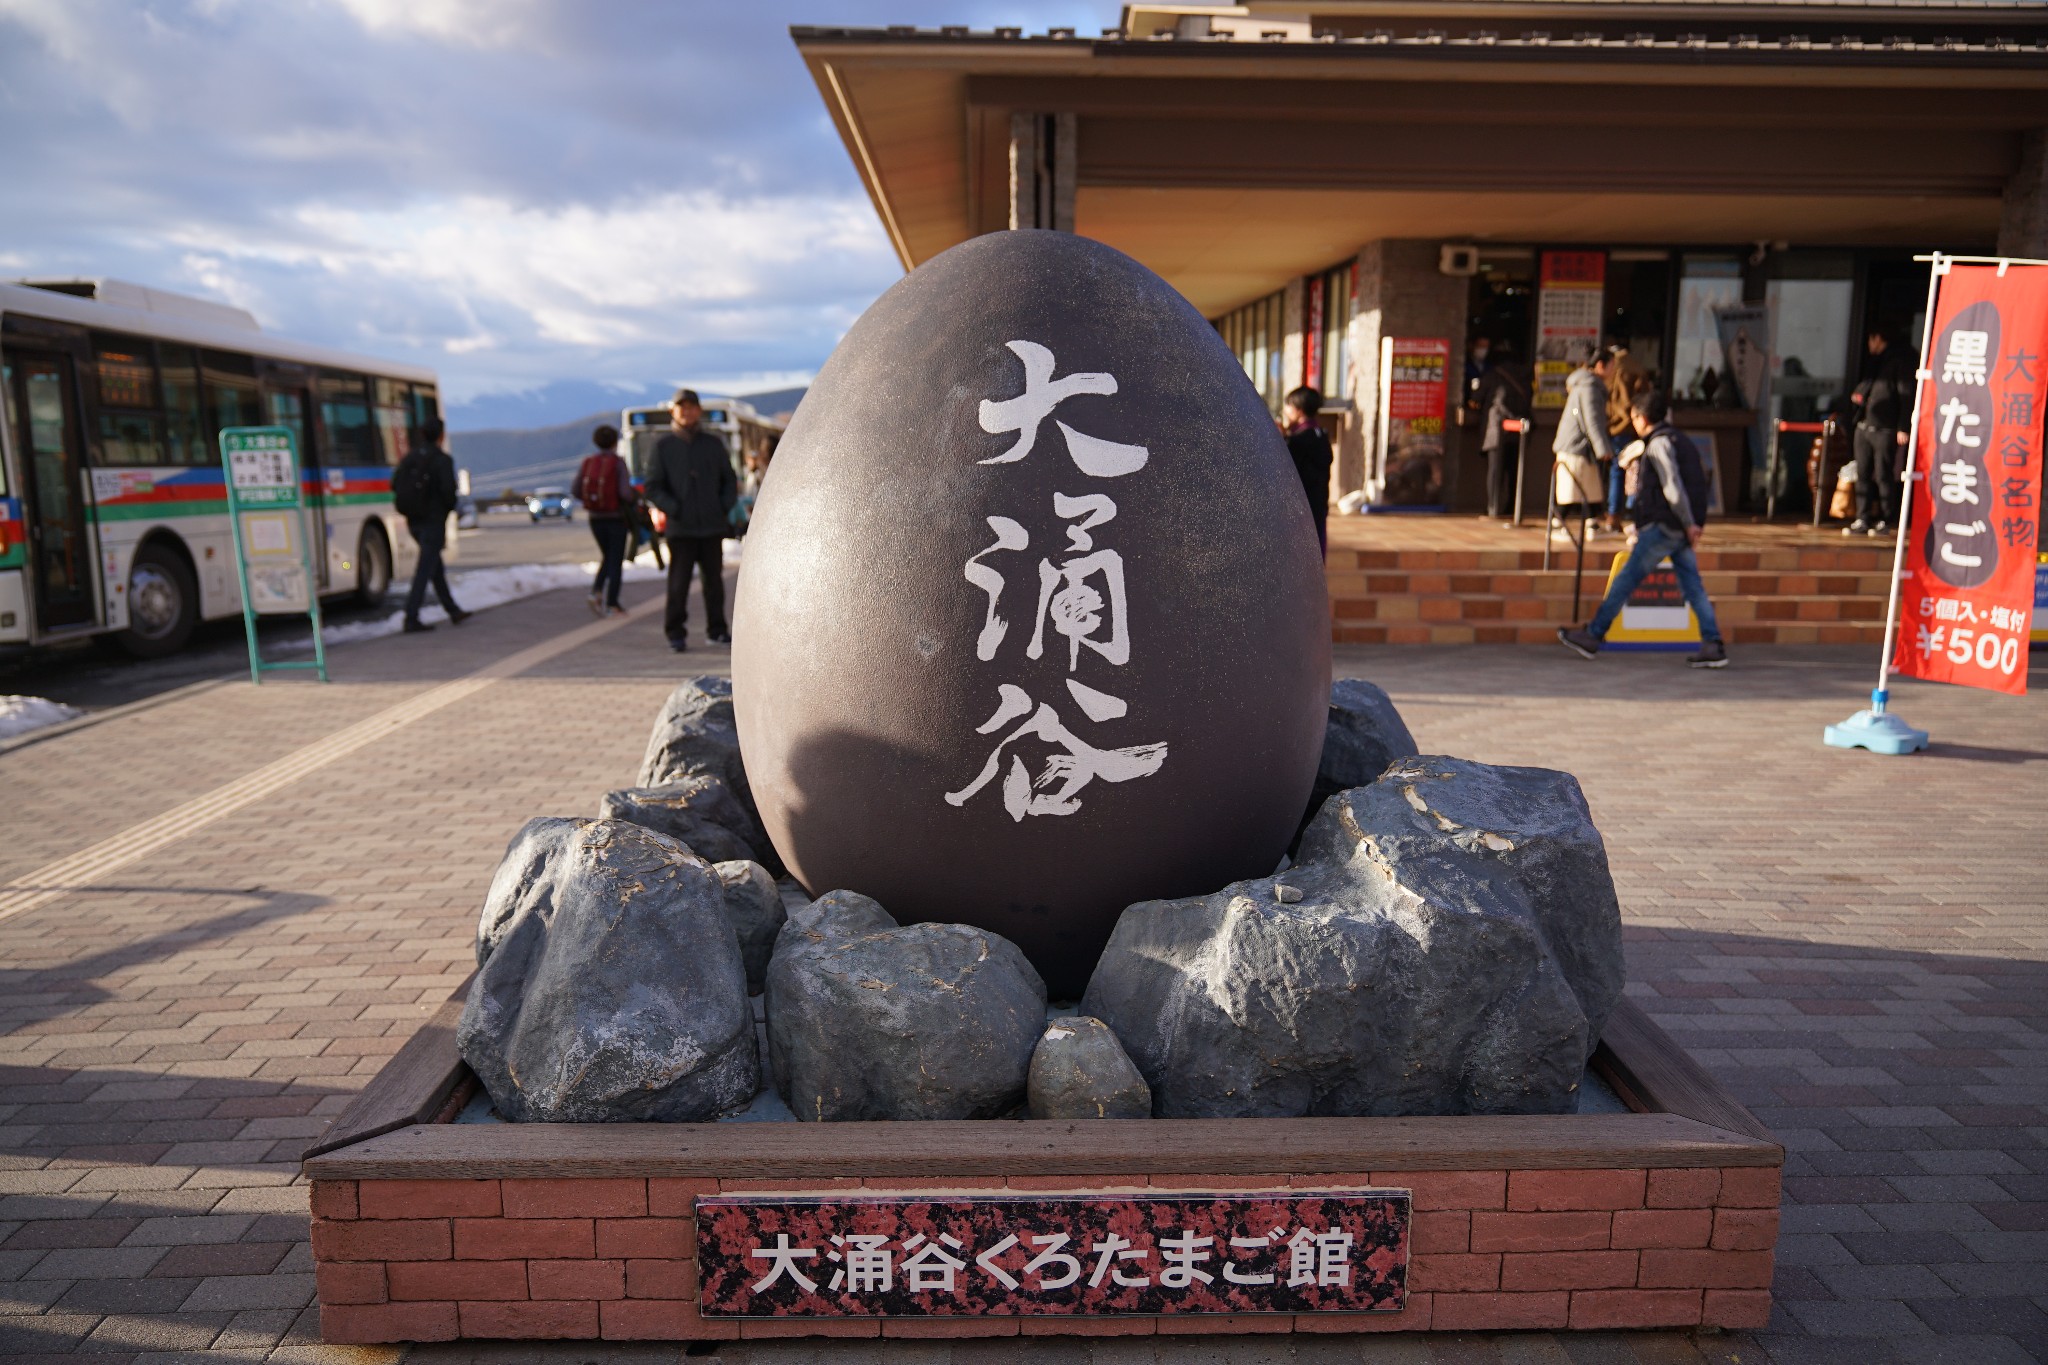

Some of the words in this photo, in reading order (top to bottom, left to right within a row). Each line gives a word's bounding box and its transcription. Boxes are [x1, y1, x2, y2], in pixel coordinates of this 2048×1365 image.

[1940, 329, 1990, 568] 黒たまご
[2000, 348, 2038, 548] 大涌谷名物
[944, 340, 1168, 822] 大涌谷
[1918, 596, 2026, 633] 5個入・塩付
[1916, 623, 2019, 675] ¥500
[751, 1227, 1353, 1293] 大涌谷くろたまご館
